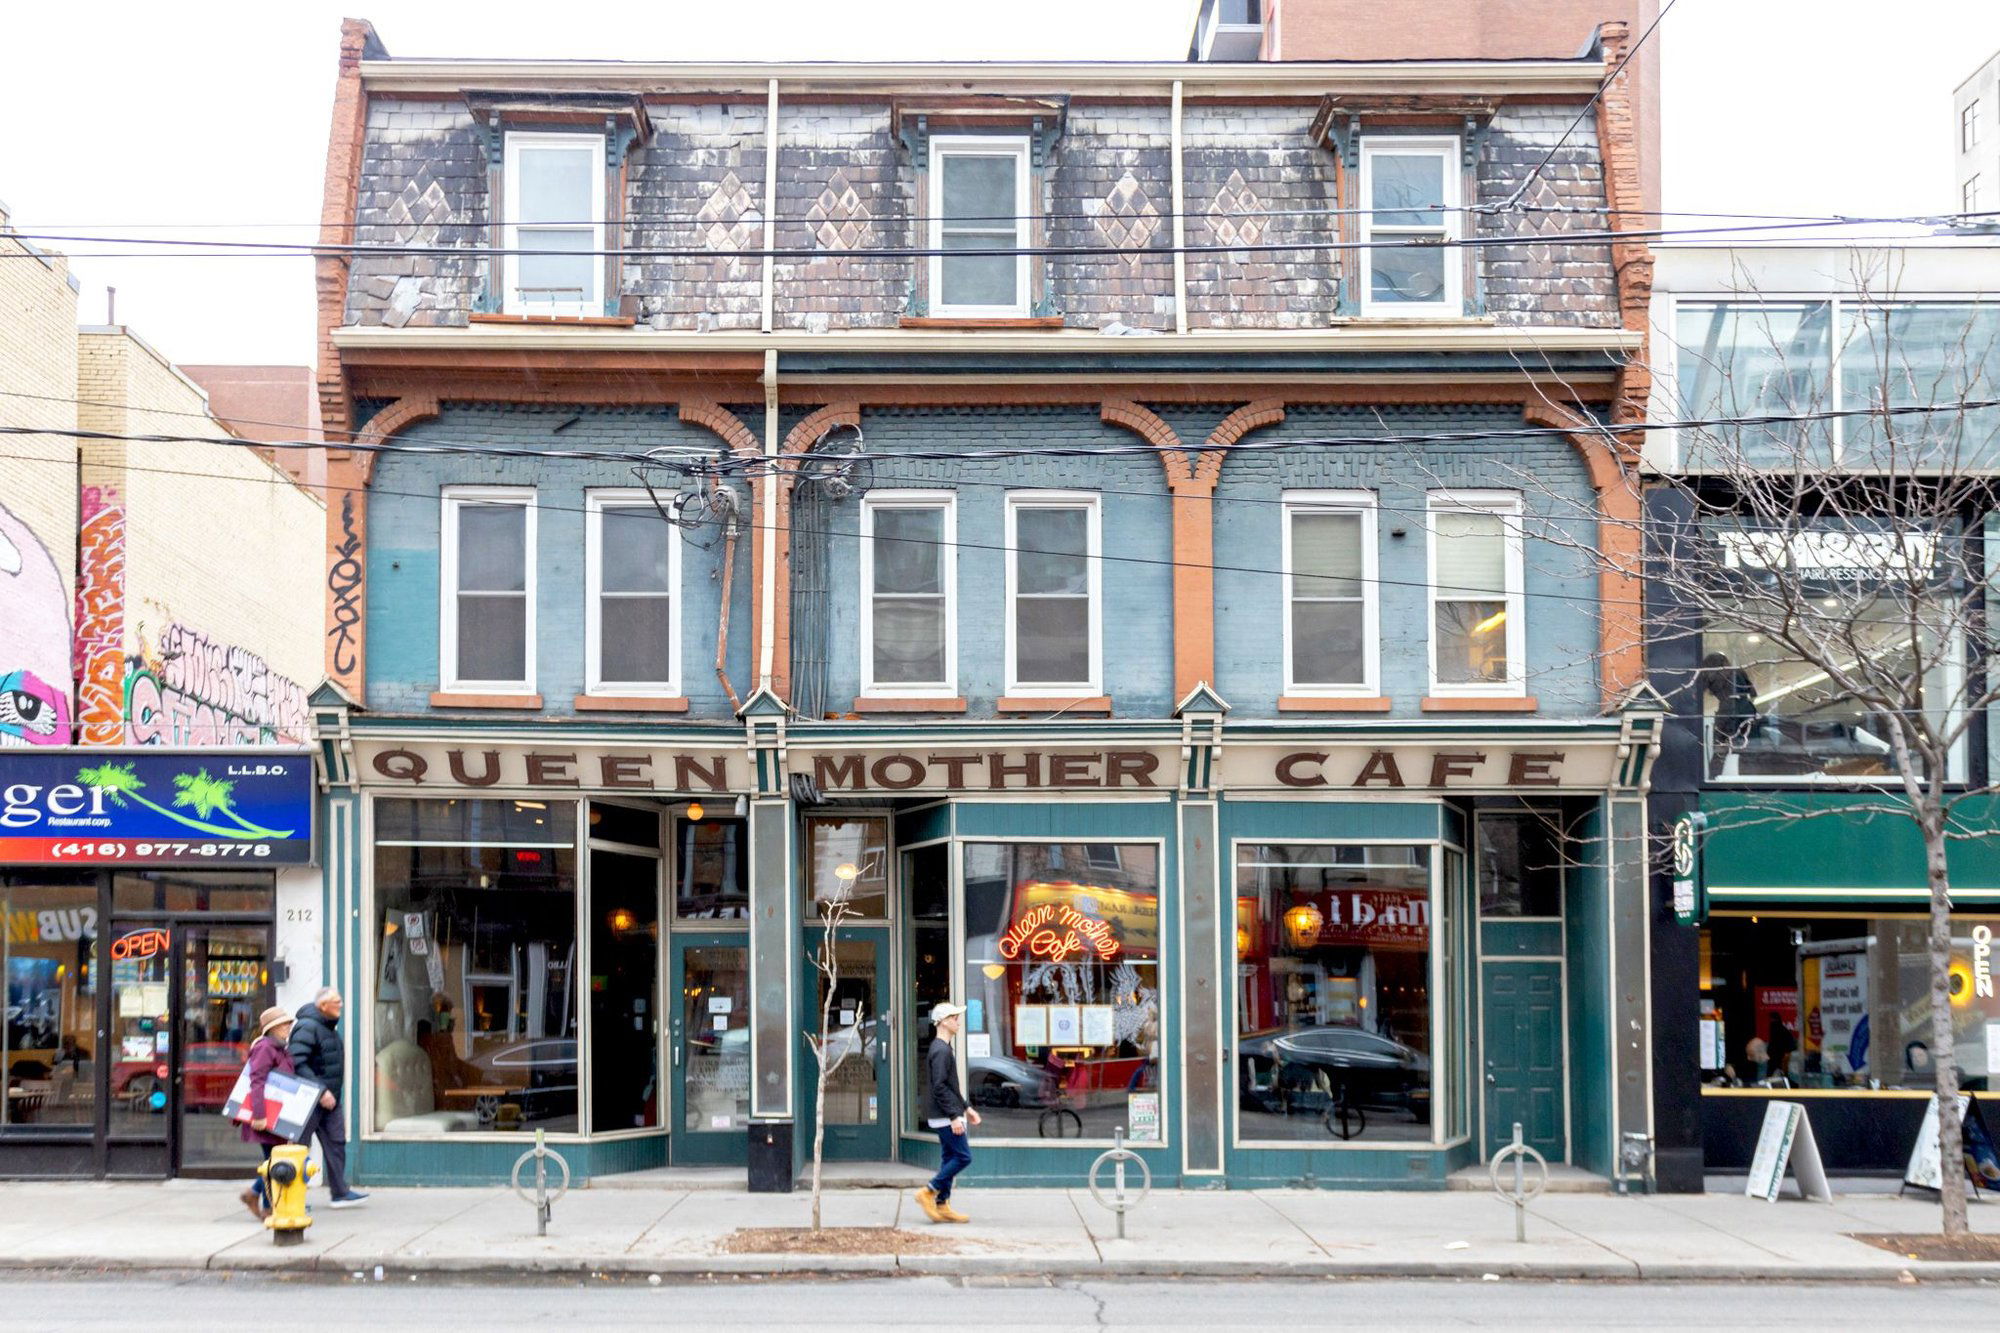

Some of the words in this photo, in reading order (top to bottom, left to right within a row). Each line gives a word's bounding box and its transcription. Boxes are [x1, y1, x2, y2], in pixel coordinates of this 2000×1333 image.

[372, 748, 730, 791] QUEEN
[812, 751, 1160, 791] MOTHER
[1274, 750, 1566, 788] CAFE
[48, 816, 92, 827] Restaurant
[51, 843, 126, 858] (416)
[135, 843, 271, 857] 977-8778
[287, 909, 312, 921] 212
[111, 930, 171, 960] OPEN
[998, 904, 1055, 959] Queen
[1031, 930, 1081, 963] Cafe
[1972, 925, 1993, 998] OPEN
